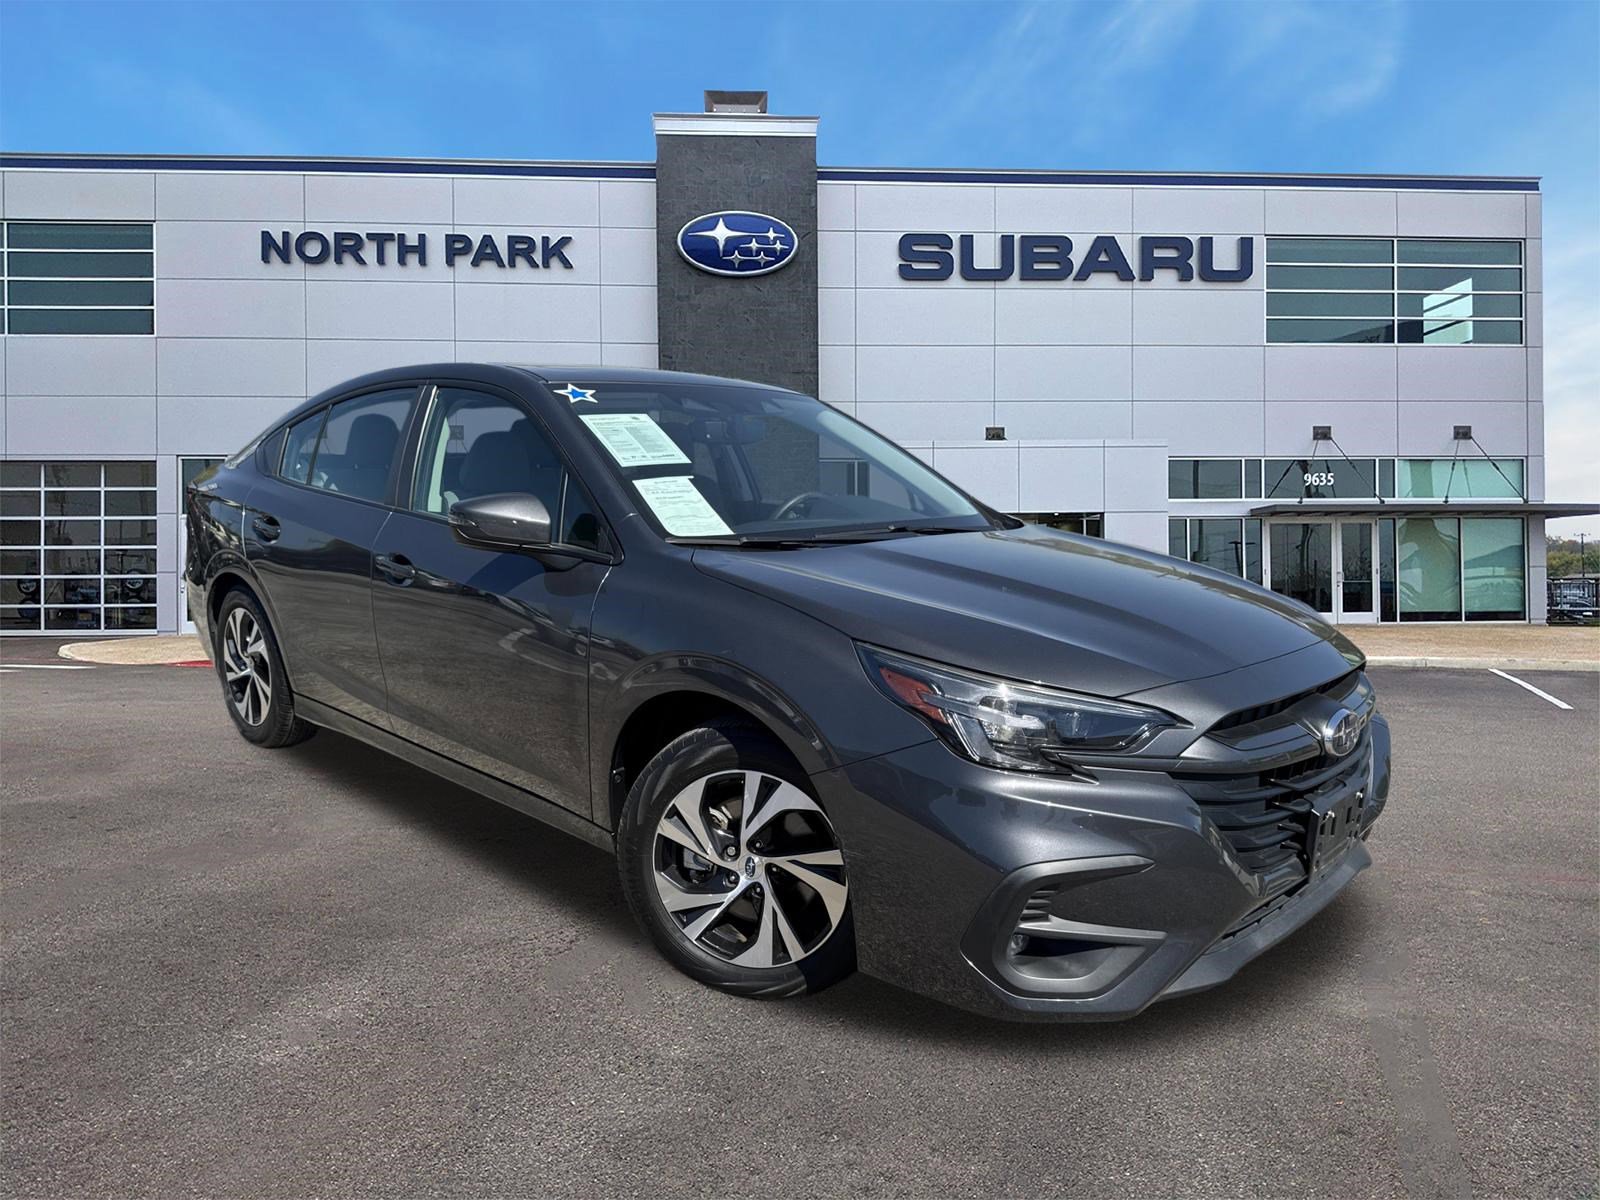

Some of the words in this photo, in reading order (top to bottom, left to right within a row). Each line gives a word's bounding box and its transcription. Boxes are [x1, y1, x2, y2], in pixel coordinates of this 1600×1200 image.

[260, 230, 428, 266] NORTH
[444, 233, 574, 269] PARK
[898, 233, 1254, 283] SUBARU
[1303, 472, 1335, 486] 9635
